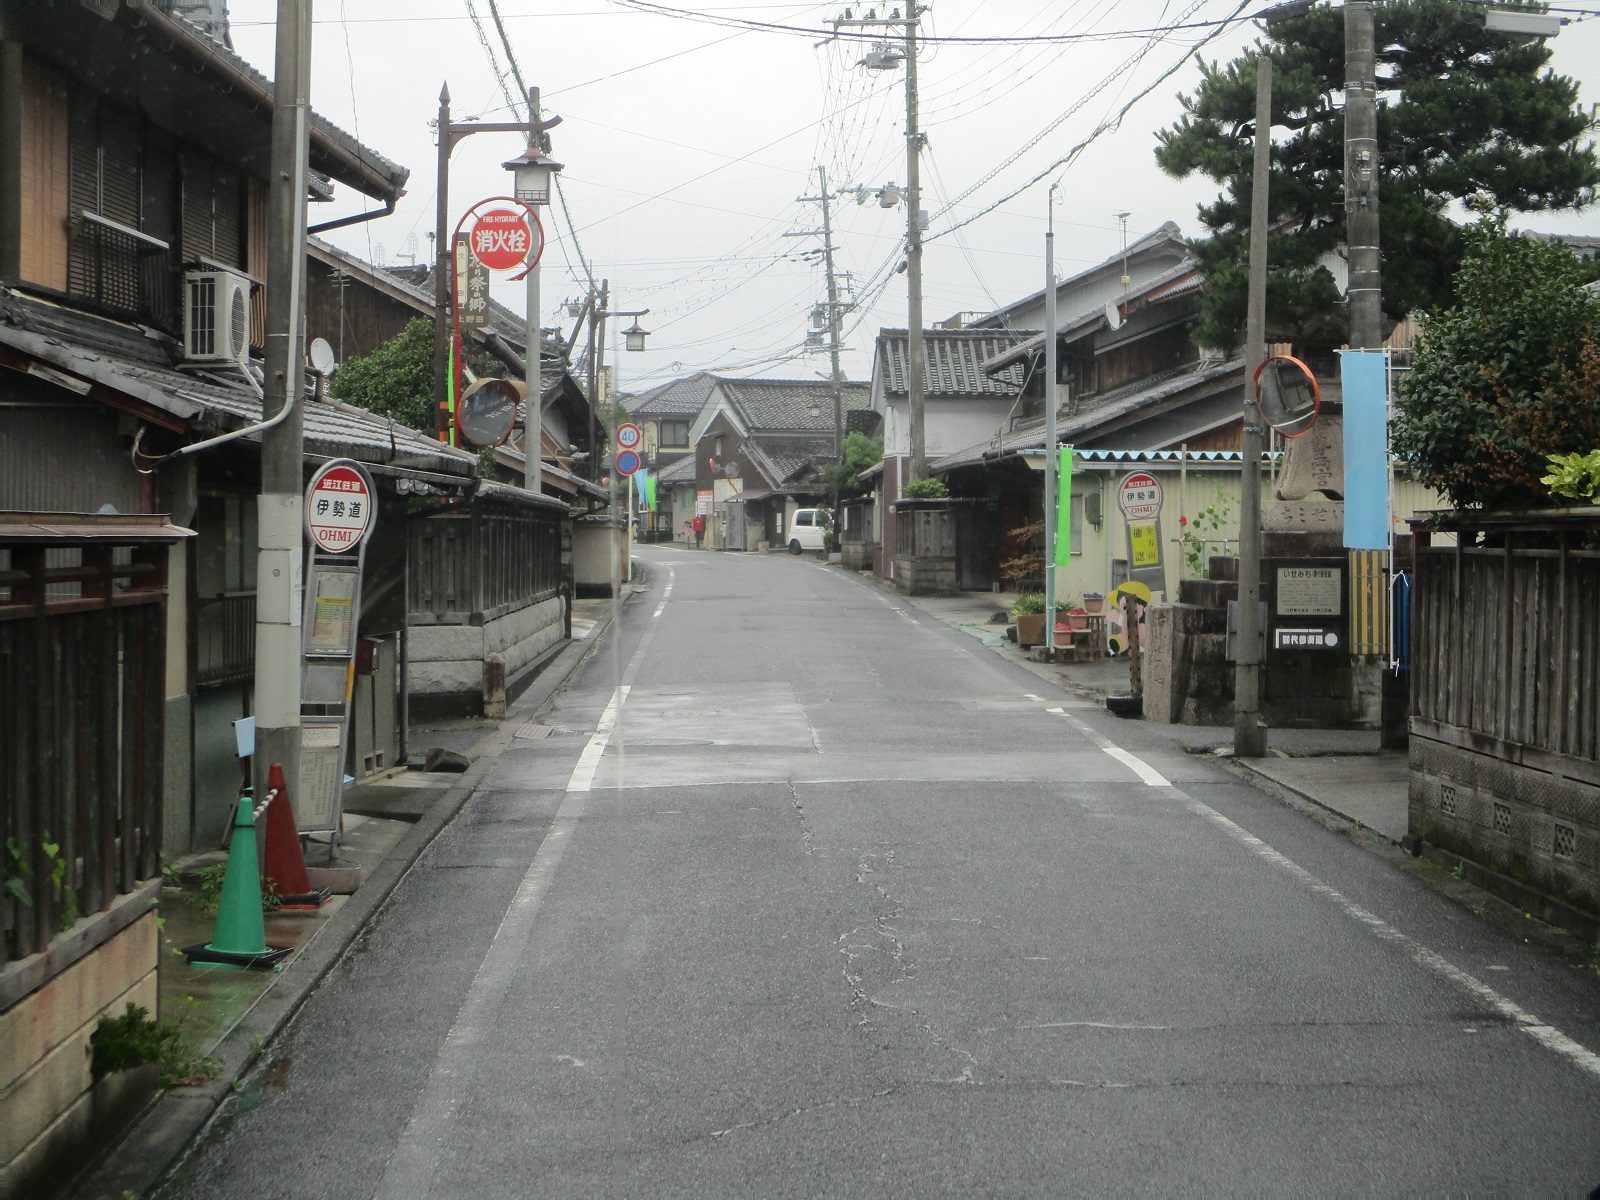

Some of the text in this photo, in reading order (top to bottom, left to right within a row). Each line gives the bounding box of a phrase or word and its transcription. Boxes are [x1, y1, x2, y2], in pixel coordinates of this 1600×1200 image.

[494, 215, 519, 223] HYDRANT
[476, 229, 526, 252] 消火栓
[621, 430, 635, 442] 40
[322, 479, 360, 491] 近江鉄道
[1128, 480, 1153, 488] 近江鉄道
[1127, 490, 1156, 501] 伊勢道
[317, 499, 361, 518] 伊勢道
[1131, 506, 1153, 514] OHMI
[319, 529, 353, 542] OHMI
